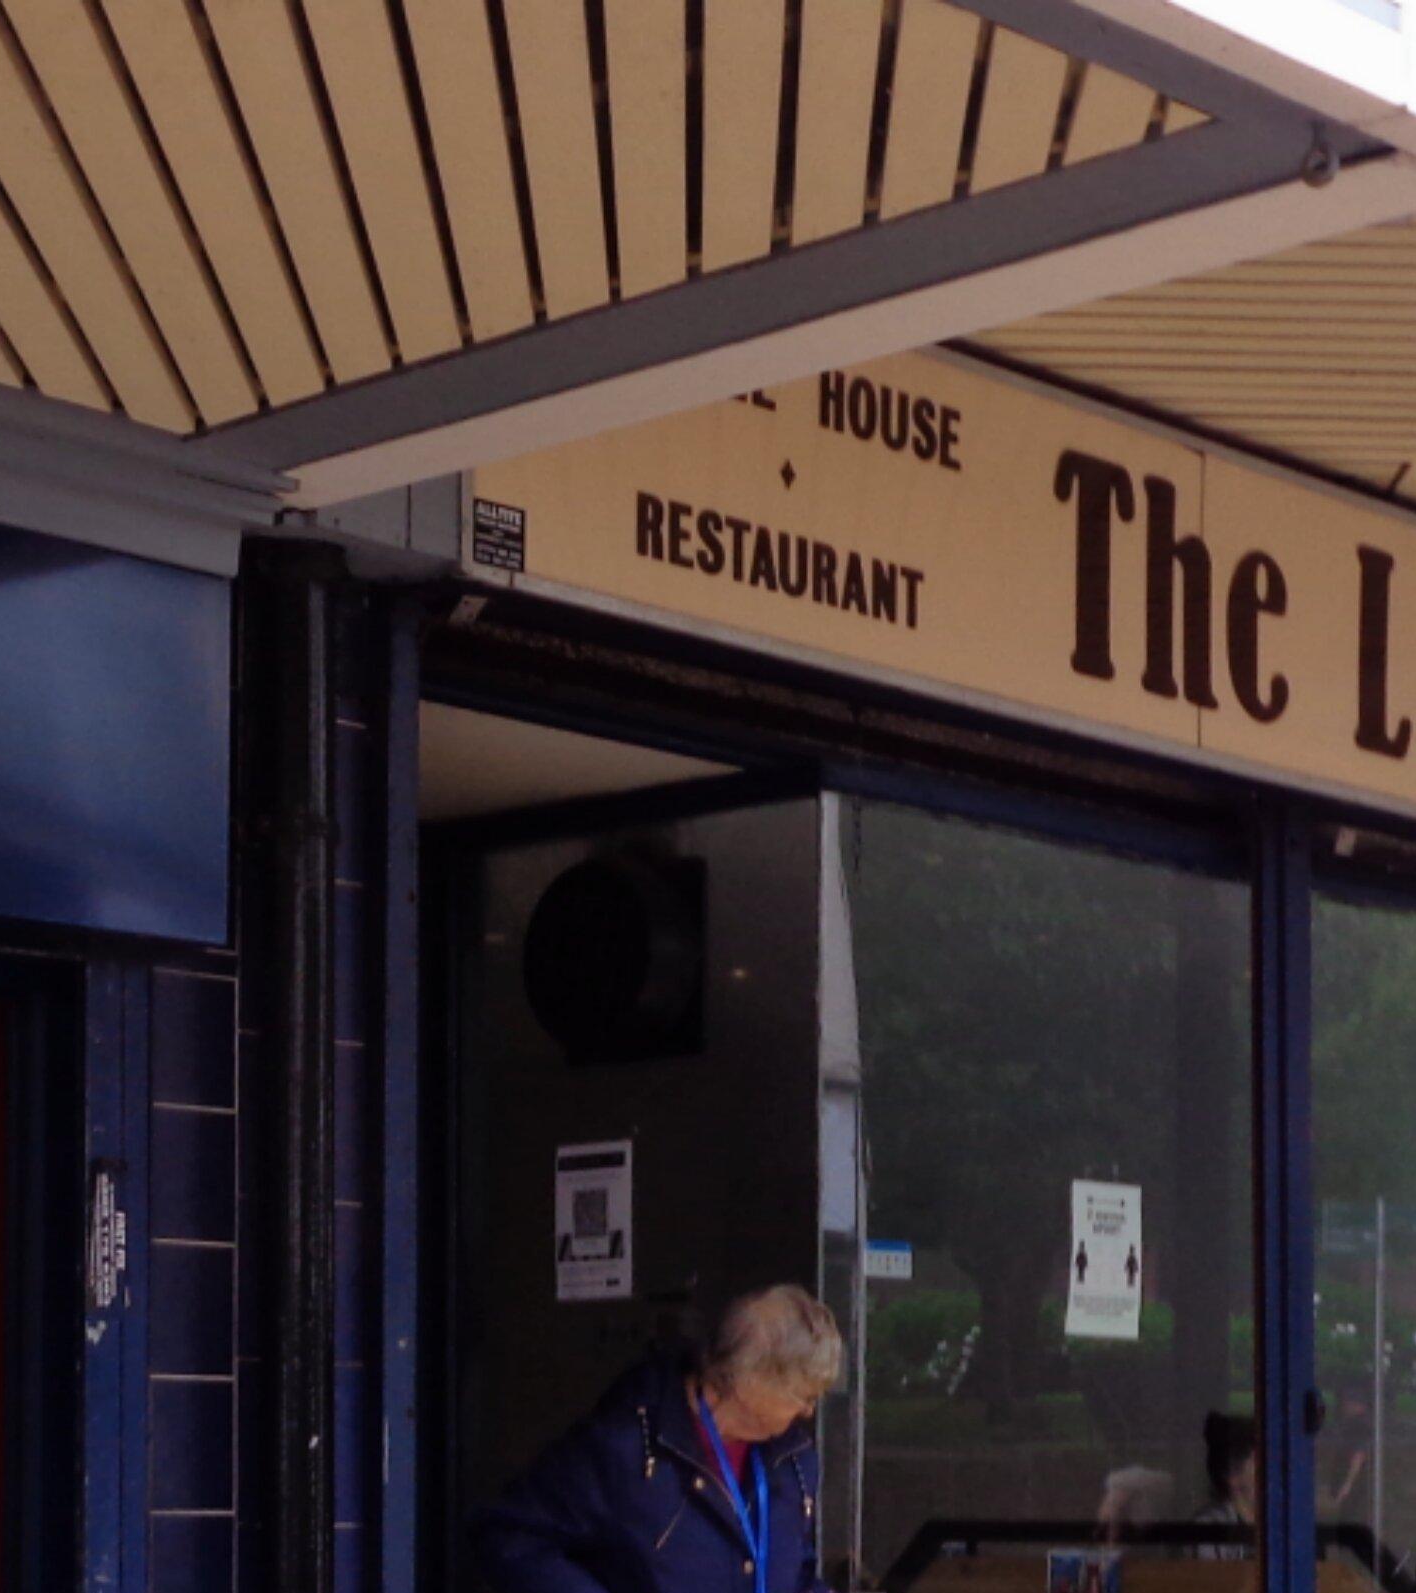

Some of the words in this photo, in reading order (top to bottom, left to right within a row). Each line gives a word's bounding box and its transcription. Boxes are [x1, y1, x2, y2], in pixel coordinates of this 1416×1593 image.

[819, 370, 961, 471] HOUSE
[636, 490, 925, 630] RESTAURANT
[1054, 448, 1289, 724] The
